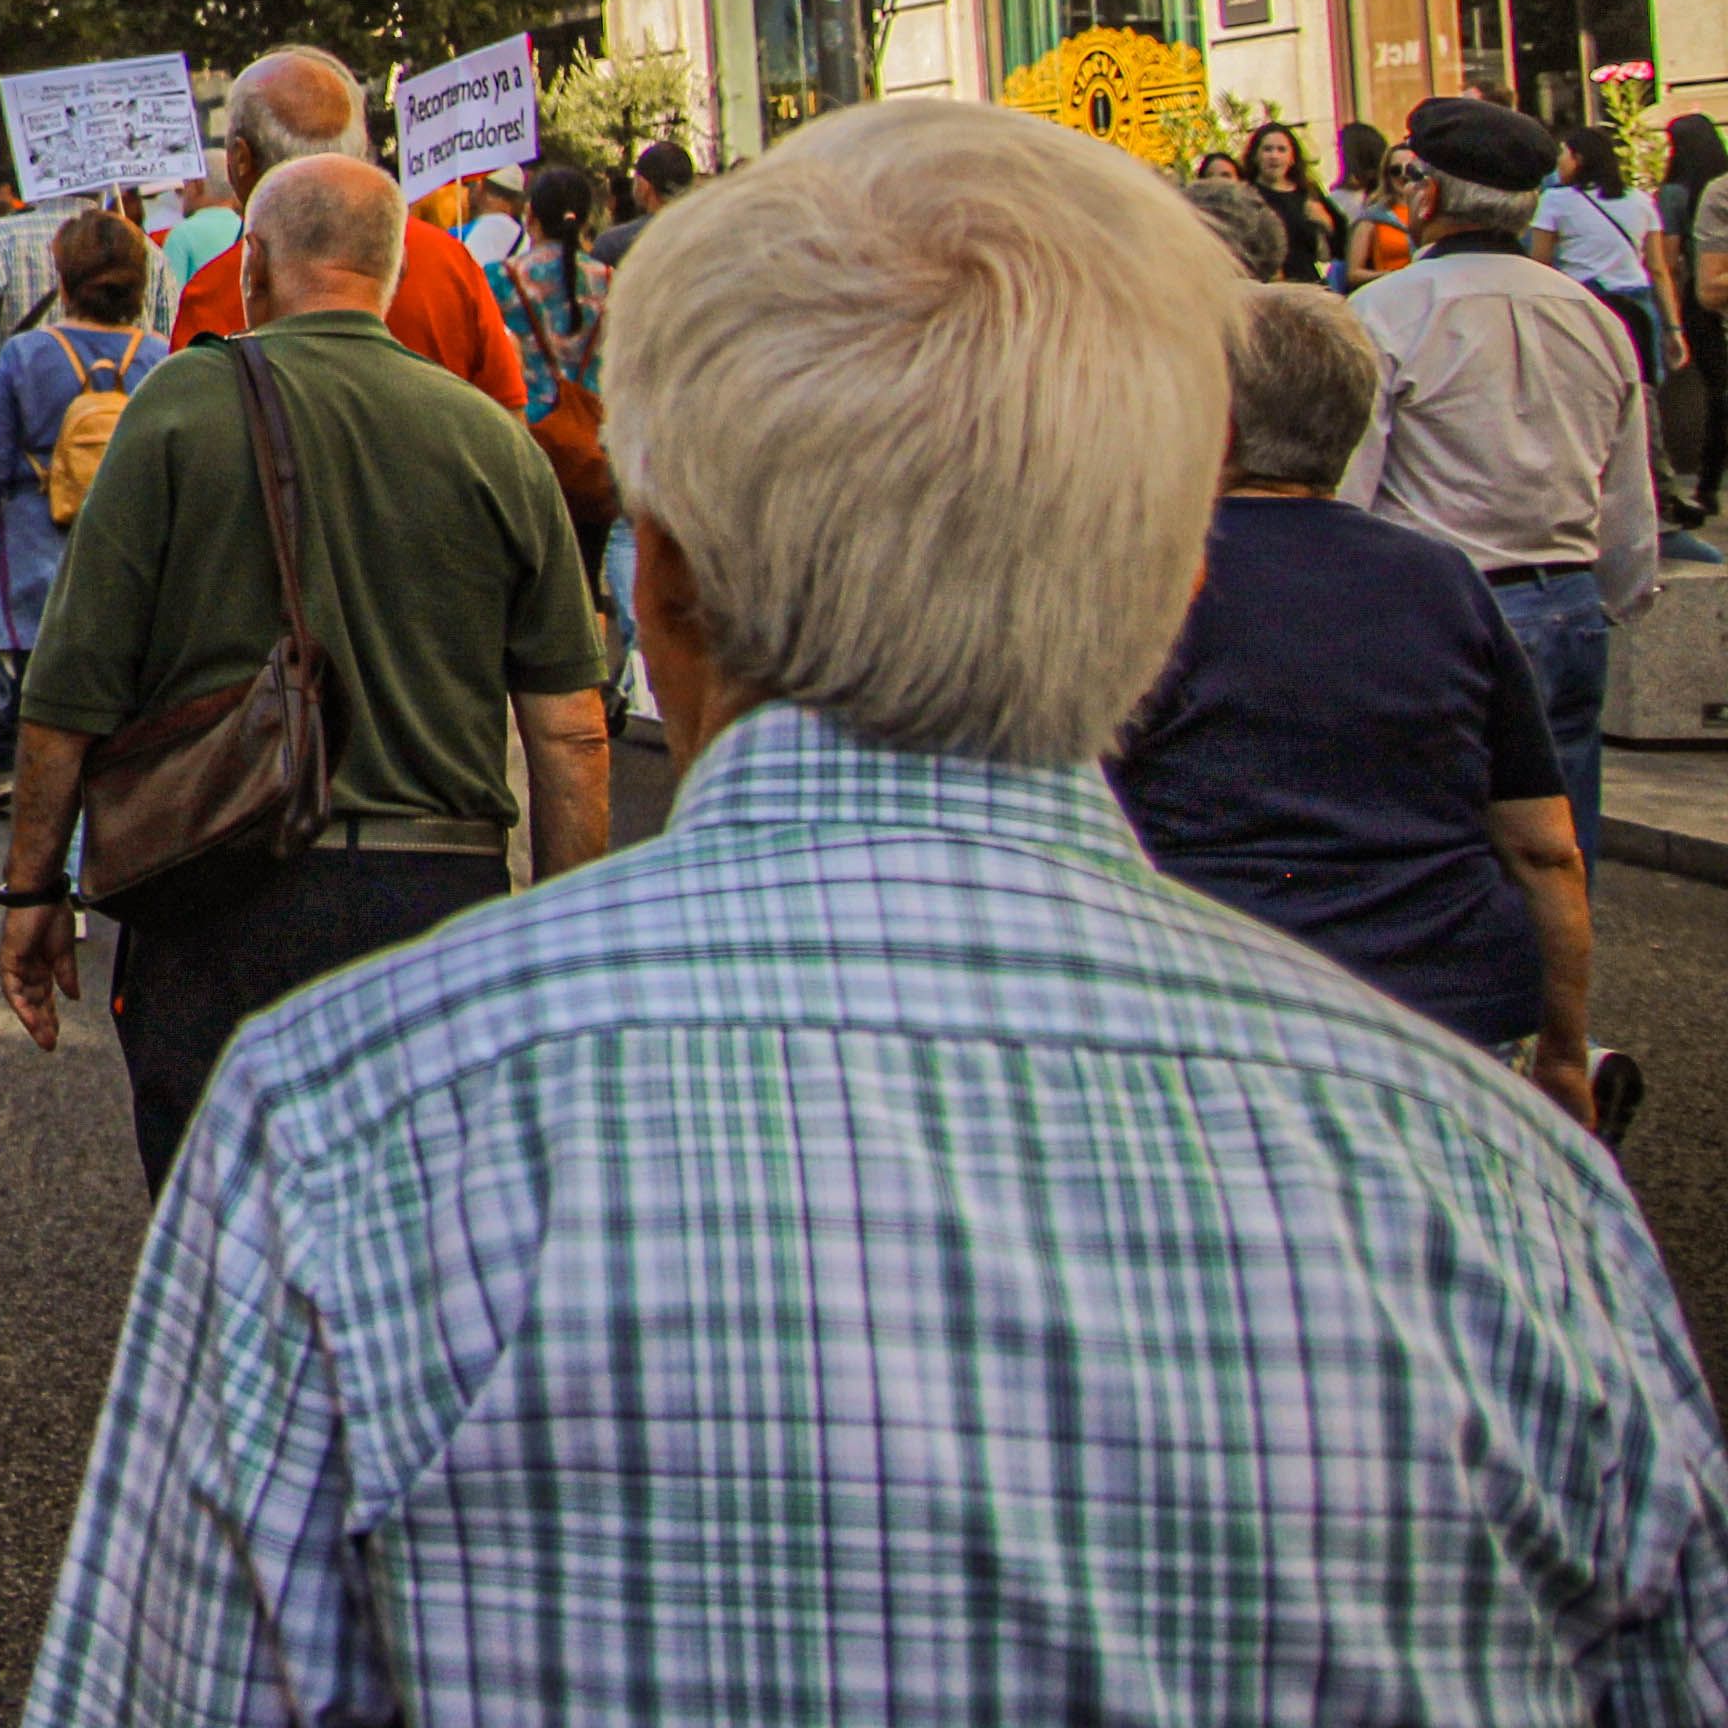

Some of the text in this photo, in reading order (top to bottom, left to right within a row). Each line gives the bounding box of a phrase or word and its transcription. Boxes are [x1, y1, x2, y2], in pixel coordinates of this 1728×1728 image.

[493, 69, 509, 105] ya
[513, 65, 523, 88] a
[407, 107, 525, 176] los recortadores!
